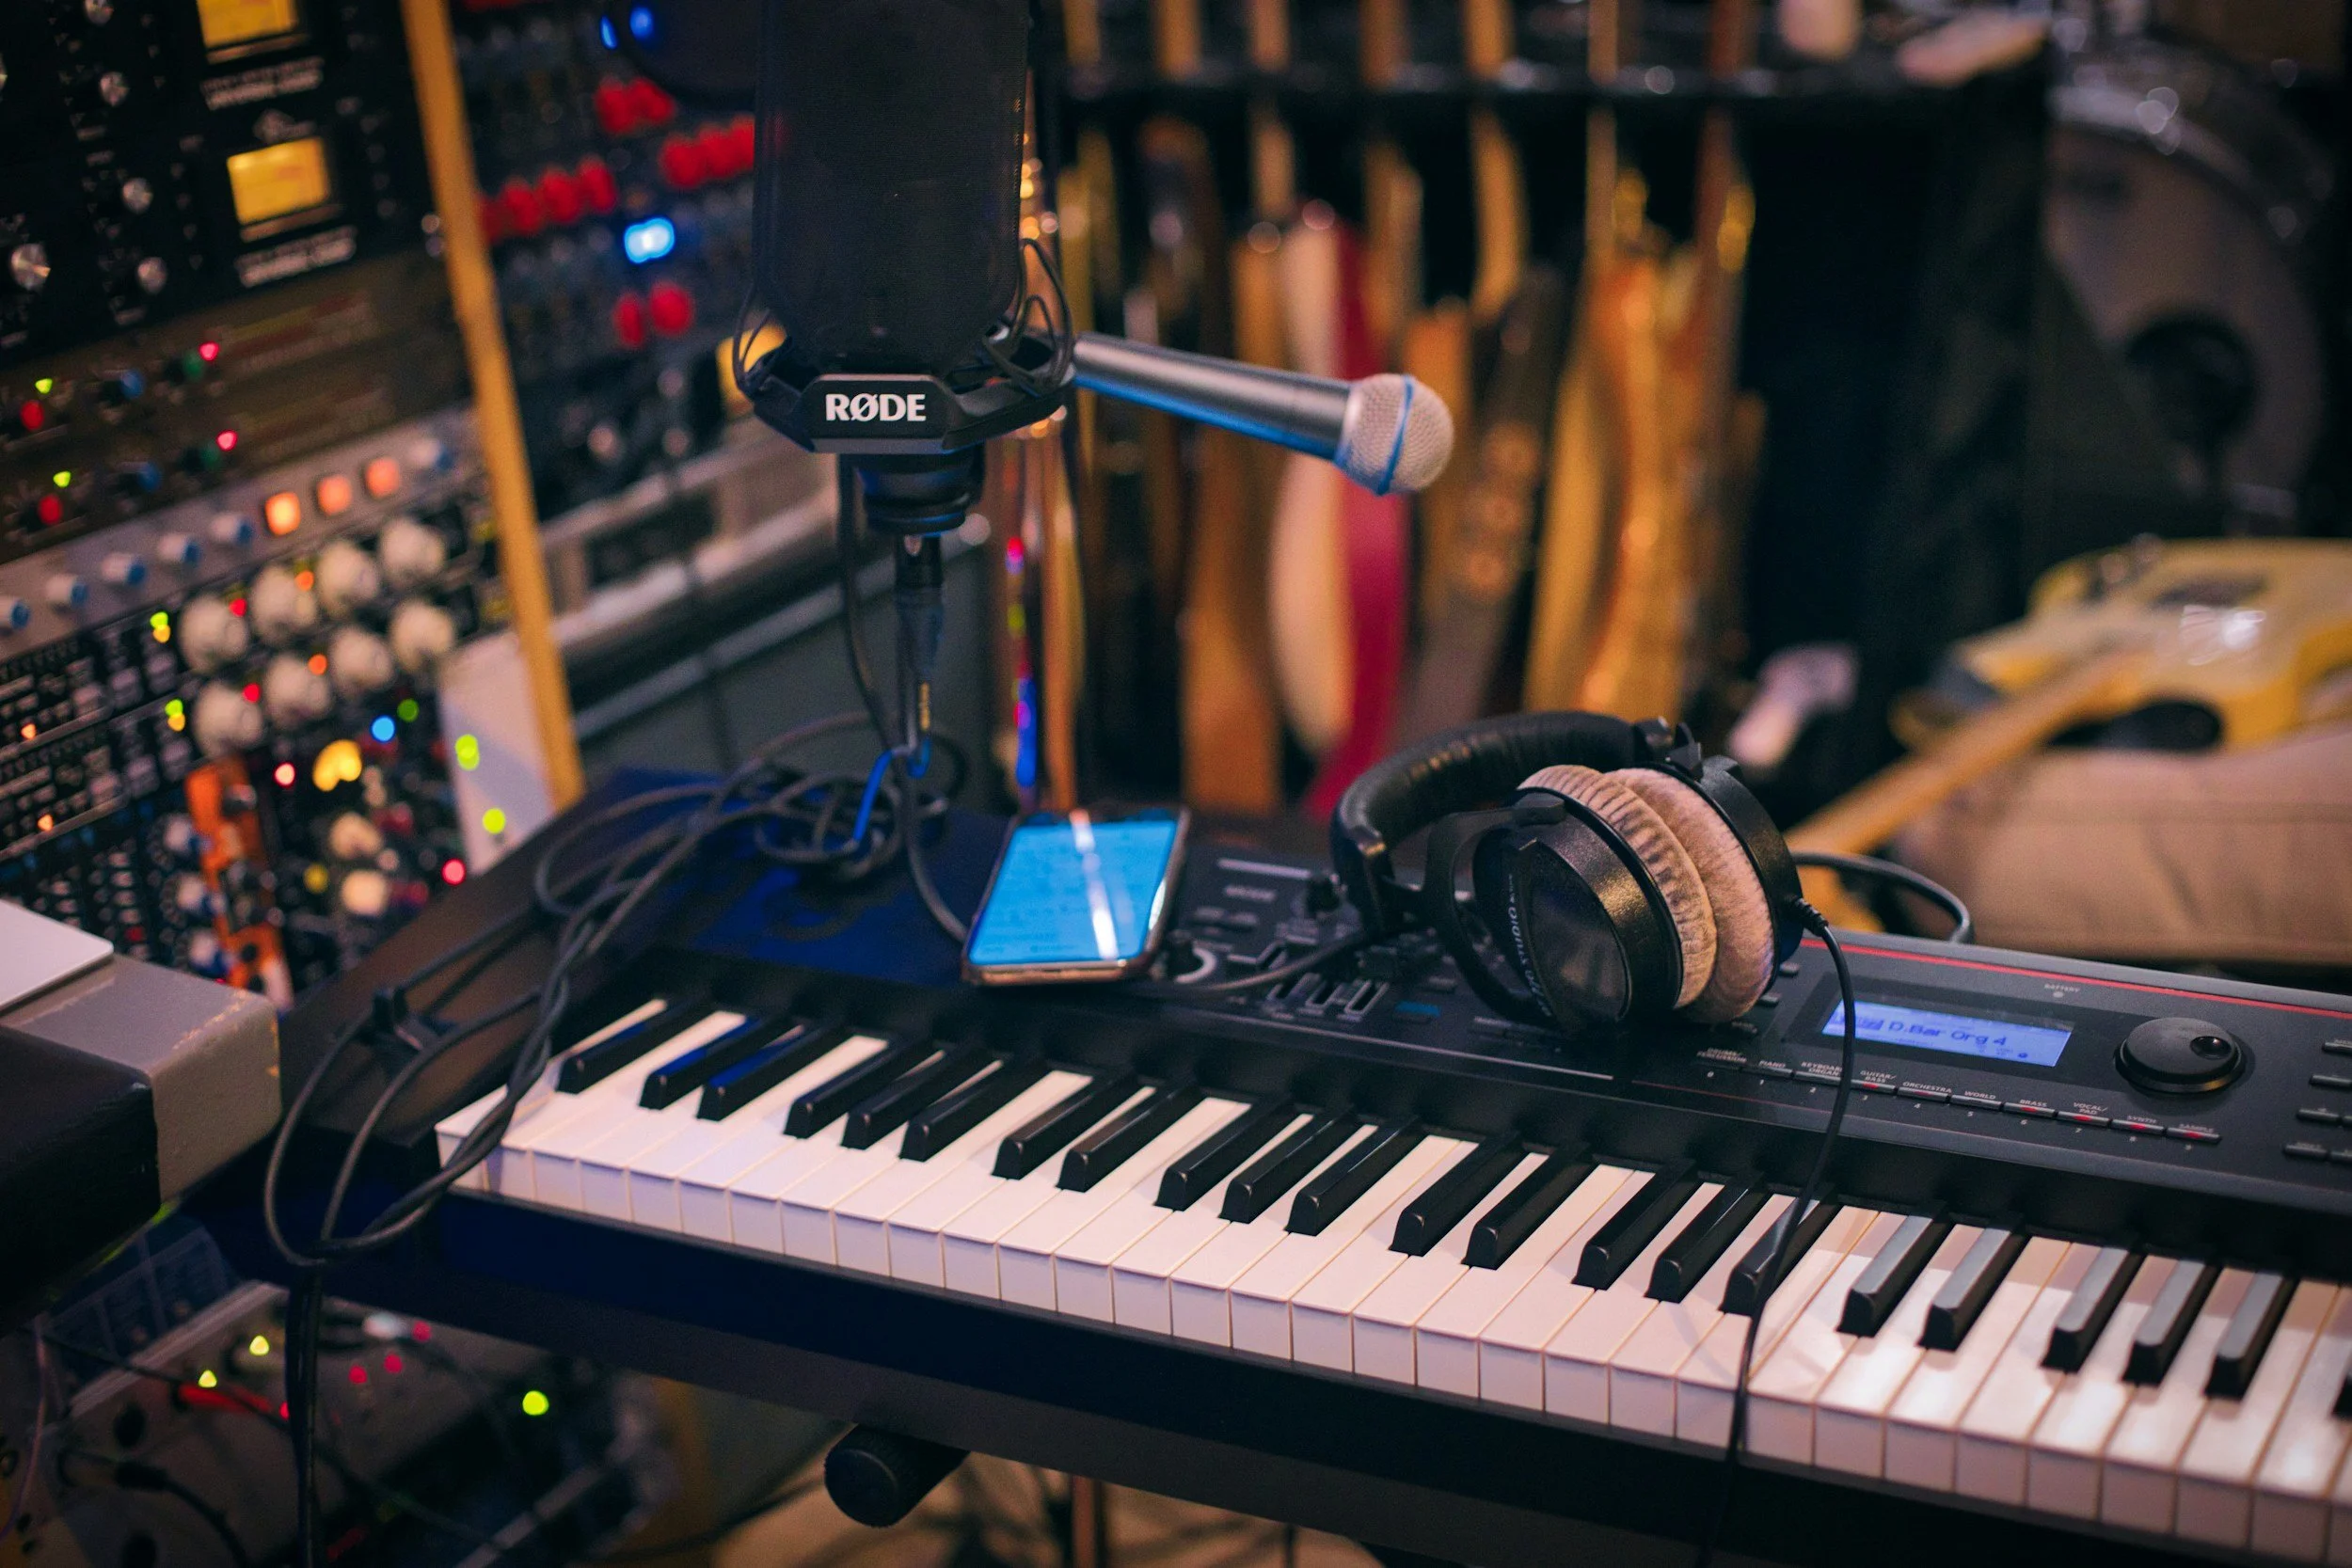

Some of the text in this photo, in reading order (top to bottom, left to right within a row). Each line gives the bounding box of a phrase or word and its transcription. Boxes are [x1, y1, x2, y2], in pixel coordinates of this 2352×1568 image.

[825, 393, 926, 421] RØDE
[1508, 906, 1528, 965] STUDIO
[1950, 1029, 1989, 1046] Org
[1993, 1035, 2007, 1046] 4
[1758, 1060, 1786, 1069] PIANO
[1808, 1068, 1839, 1077] ORGAN
[1860, 1069, 1897, 1081] GUITAR/
[1902, 1081, 1952, 1094] ORCHESTRA
[1964, 1090, 1996, 1100] WORLD
[2019, 1099, 2047, 1108] BRASS
[2073, 1101, 2108, 1113] VOCAL/
